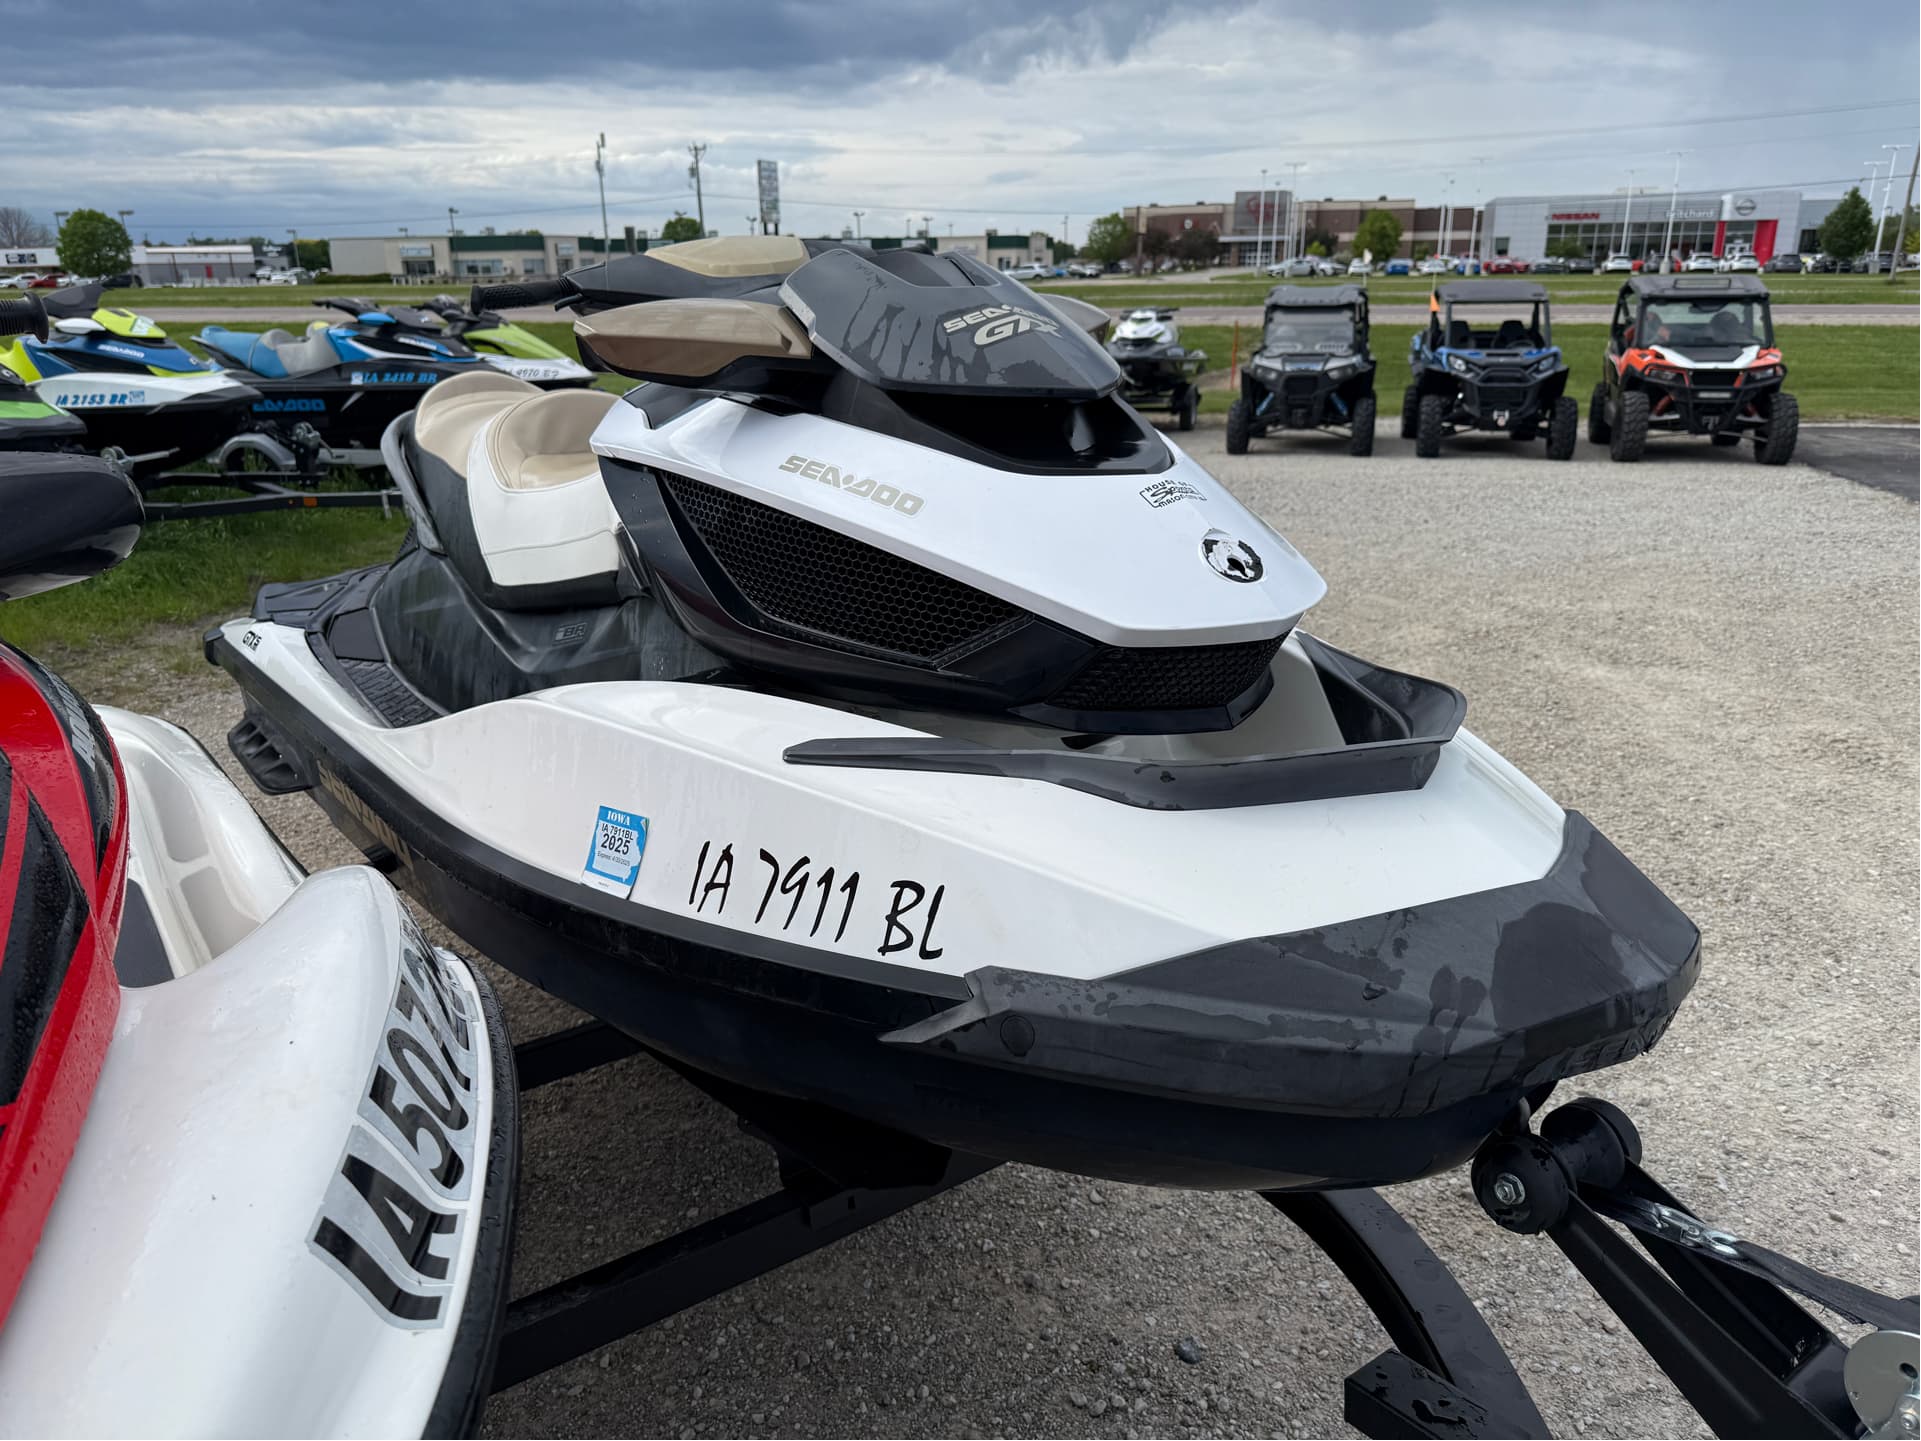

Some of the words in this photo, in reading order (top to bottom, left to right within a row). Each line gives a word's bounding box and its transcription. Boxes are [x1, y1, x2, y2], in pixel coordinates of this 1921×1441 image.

[607, 810, 631, 826] IOWA
[601, 823, 610, 834] IA
[610, 825, 634, 841] 7911BL
[600, 833, 631, 856] 2025
[689, 840, 734, 914] IA
[754, 848, 860, 943] 7911
[877, 880, 945, 960] BL
